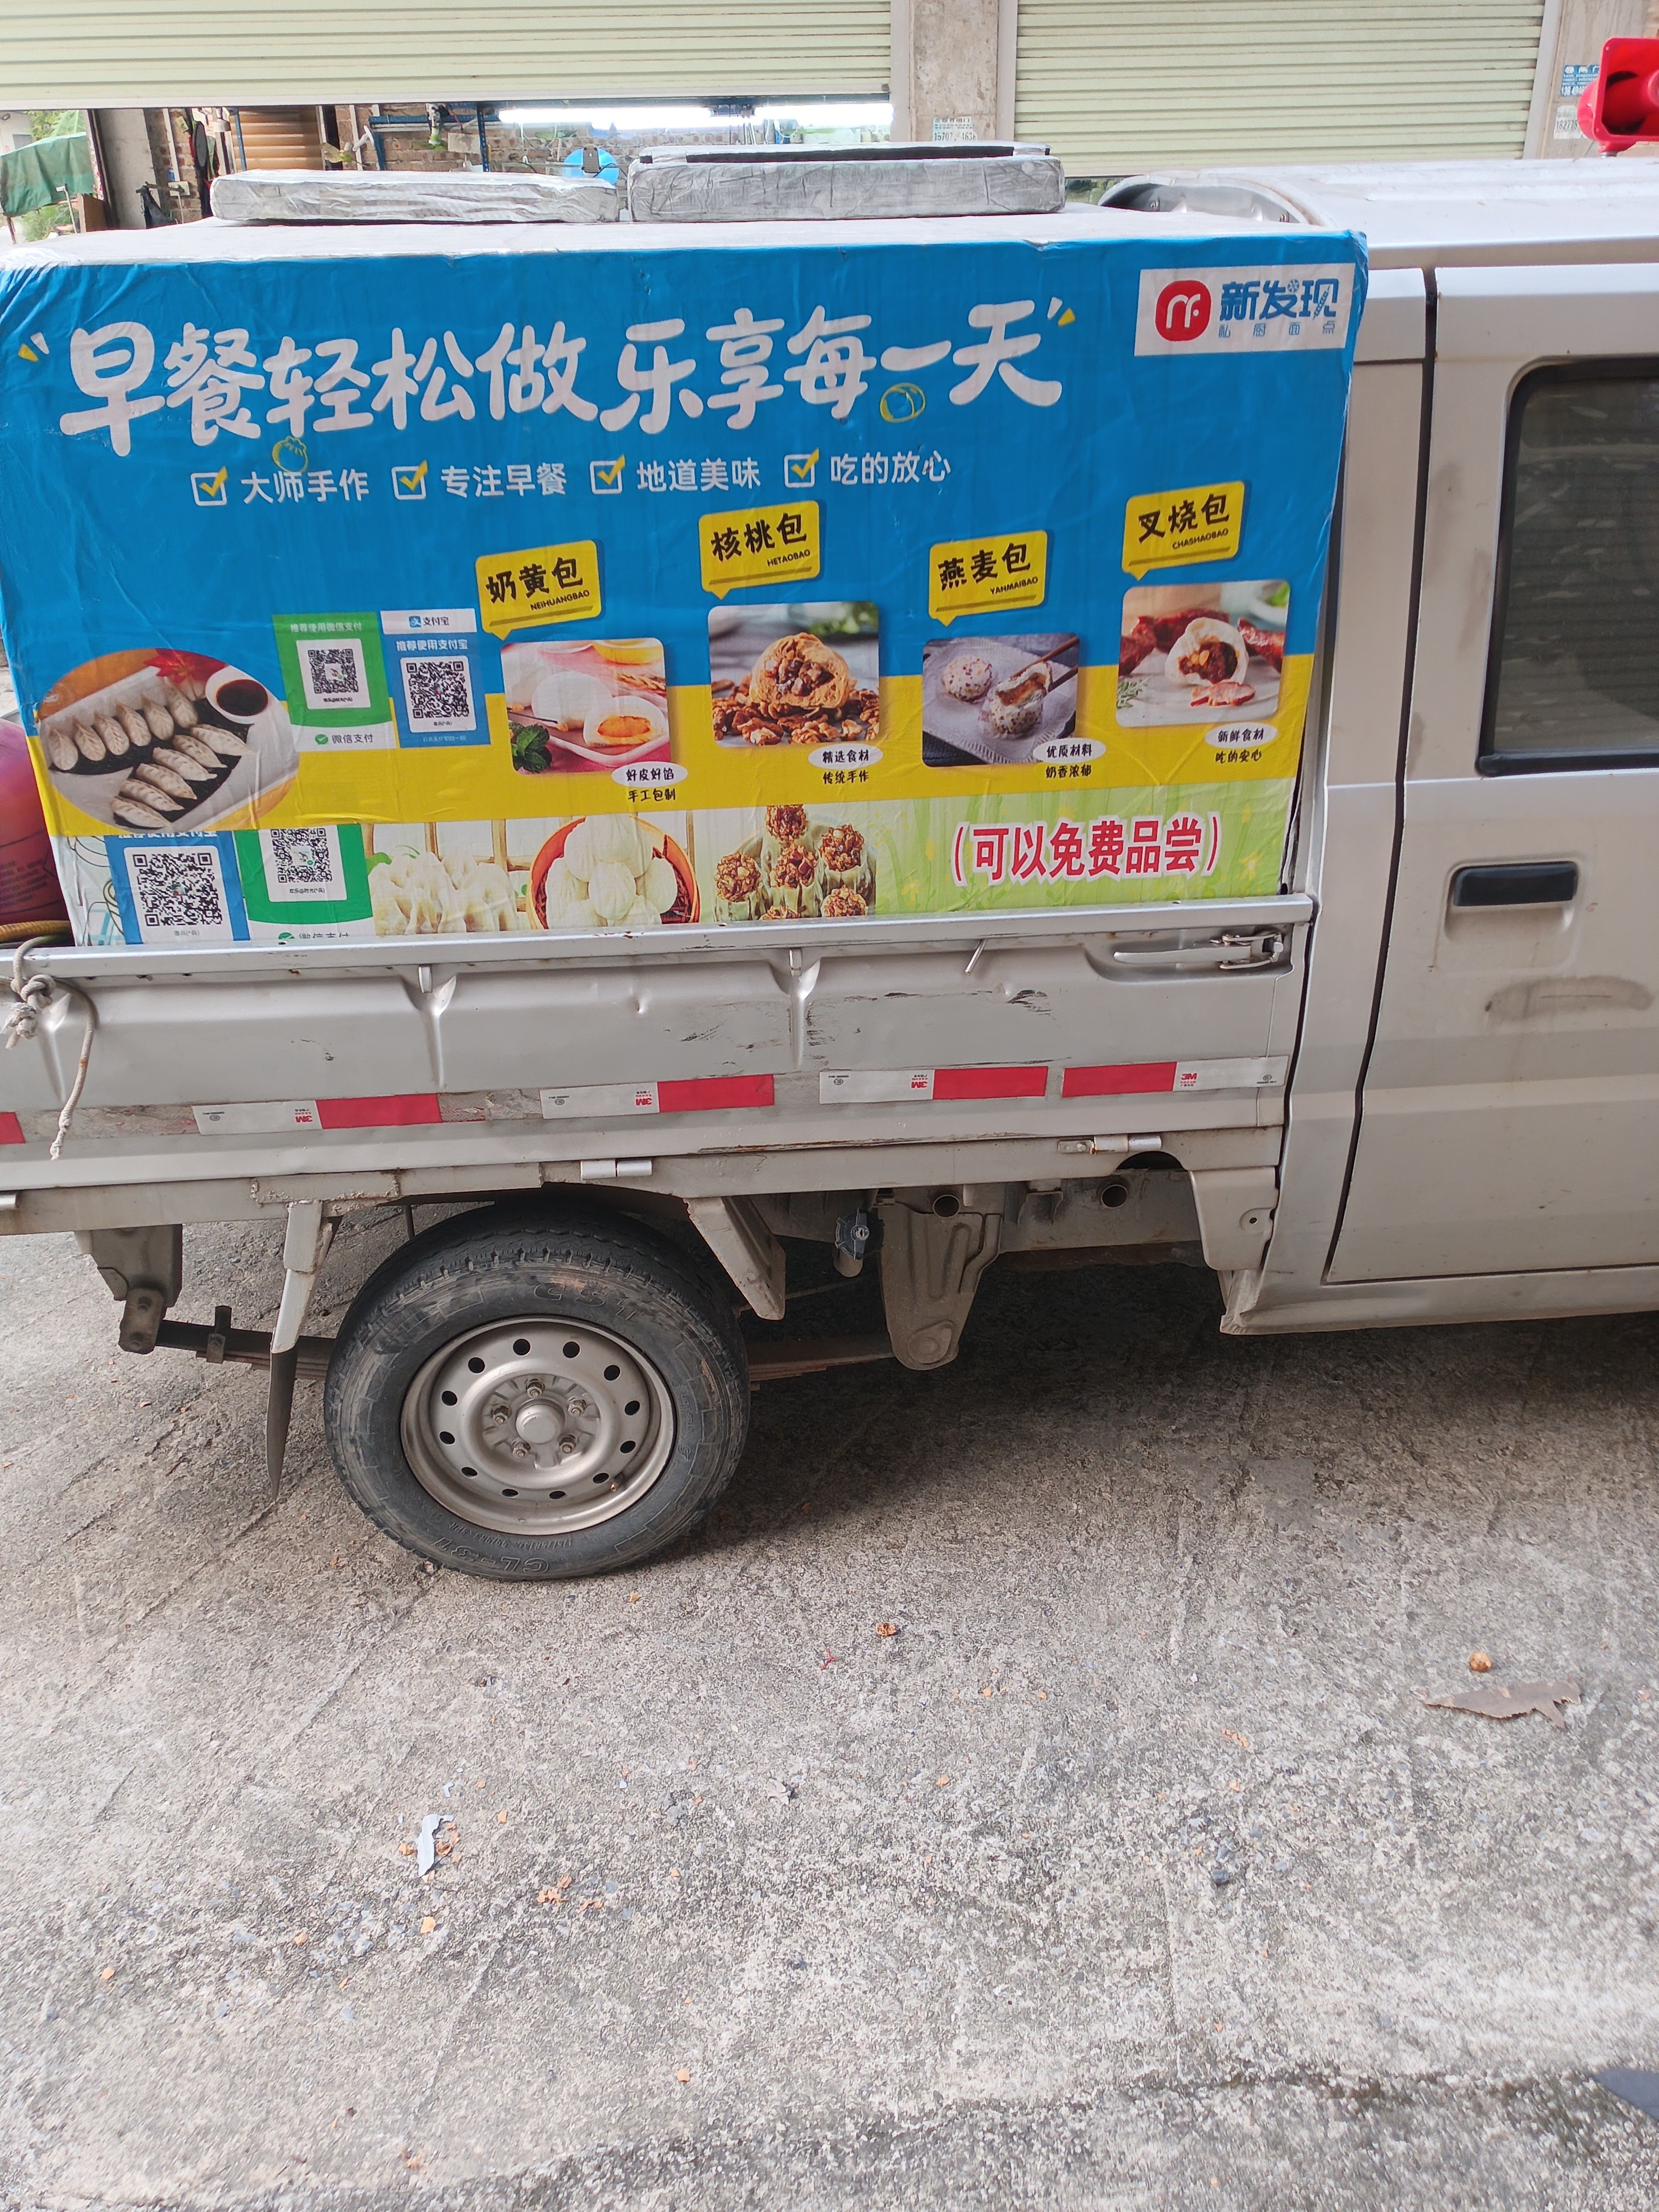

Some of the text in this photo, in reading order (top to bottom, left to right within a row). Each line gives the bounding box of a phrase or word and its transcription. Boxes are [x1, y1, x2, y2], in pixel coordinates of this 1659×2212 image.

[1219, 278, 1339, 321] 新发现
[60, 300, 1062, 457] 早餐轻松做 乐享每一天
[637, 457, 761, 490] 地道美味
[831, 449, 951, 485] 吃的放心
[240, 468, 370, 504] 大师手作
[440, 462, 567, 498] 专注早餐
[1138, 493, 1229, 543] 叉烧包
[710, 512, 807, 562] 核桃包
[1172, 527, 1229, 550] CHASHAOBAO
[767, 549, 811, 567] HETAOBAO
[937, 542, 1030, 591] 燕麦包
[485, 556, 583, 604] 奶黄包
[990, 576, 1038, 595] YANMAIBAO
[530, 589, 590, 611] NEIHUANGBAO
[423, 616, 449, 626] 支付宝
[331, 733, 374, 744] 微信支付
[1218, 727, 1264, 743] 新鲜食材
[822, 749, 869, 765] 精选食材
[1046, 742, 1092, 758] 优质材料
[626, 768, 675, 782] 好皮好馅
[822, 769, 870, 785] 传统手作
